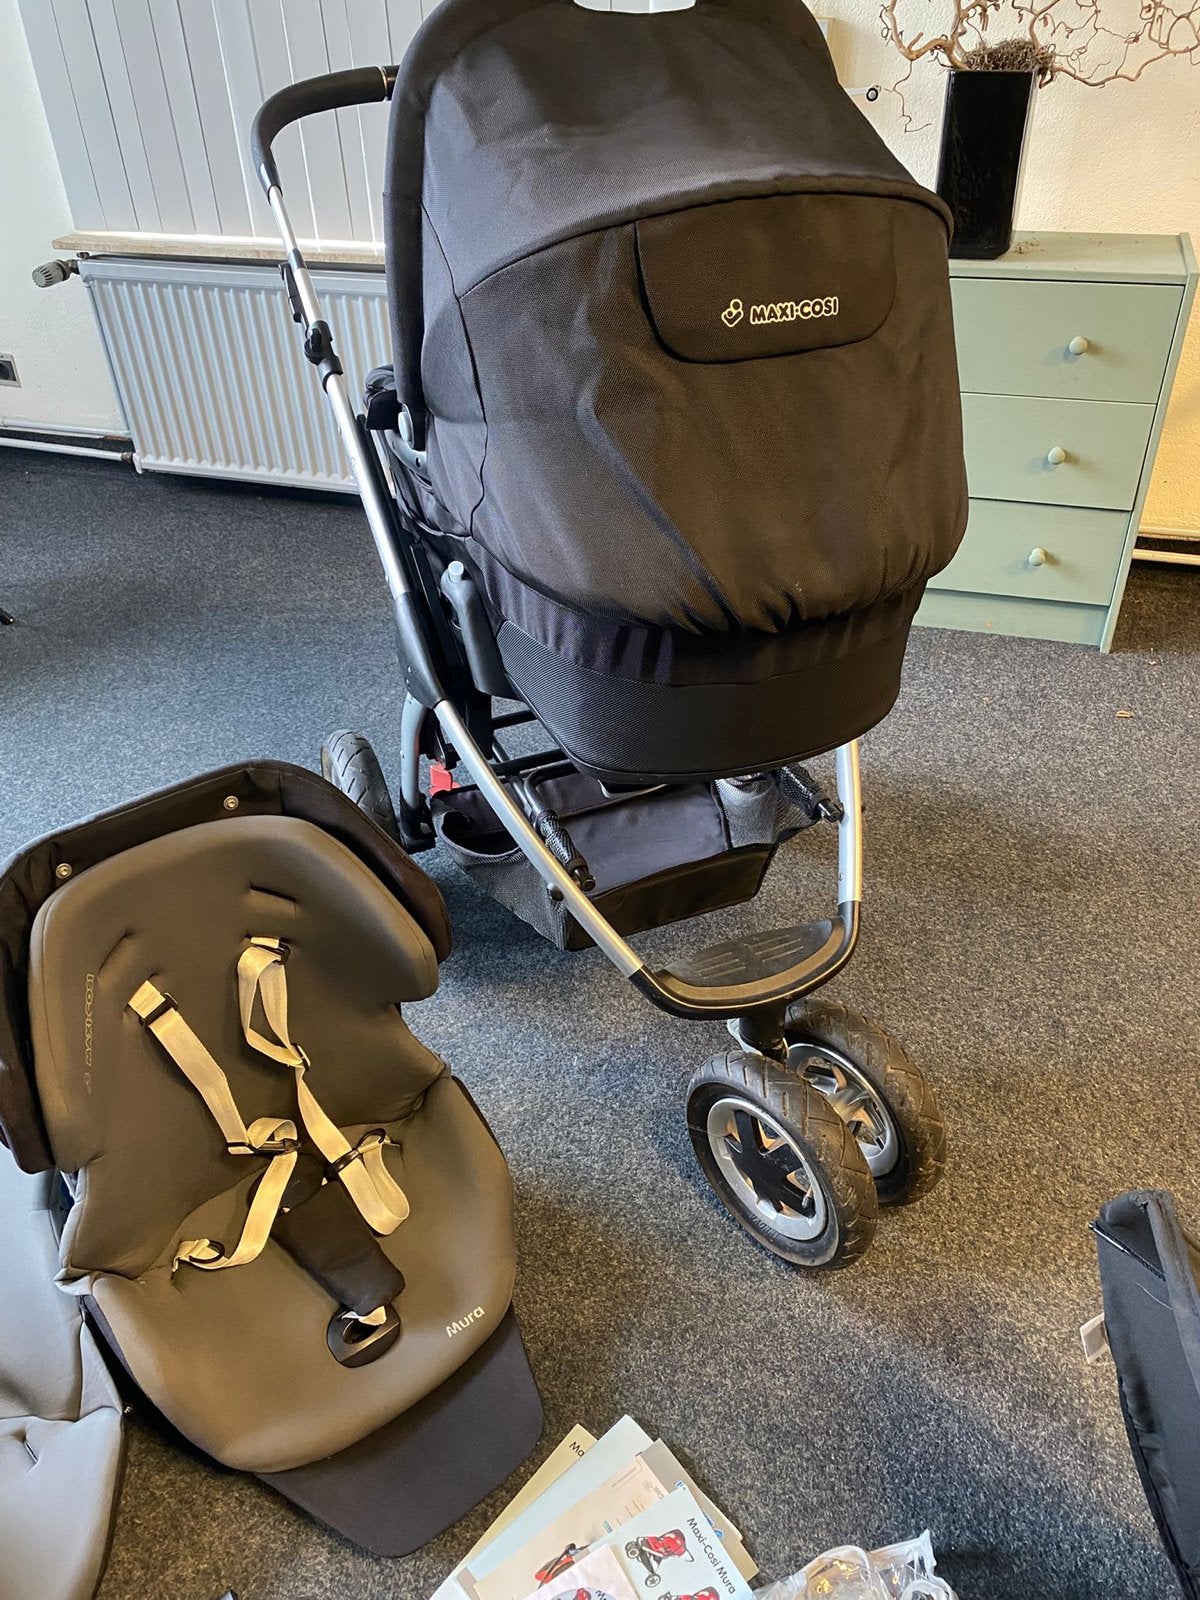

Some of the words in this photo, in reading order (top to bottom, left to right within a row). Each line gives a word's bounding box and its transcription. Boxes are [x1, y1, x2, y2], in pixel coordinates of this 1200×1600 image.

[446, 1306, 485, 1338] Mura
[687, 1517, 722, 1568] Maxi-Cosi
[716, 1566, 736, 1594] Mura
